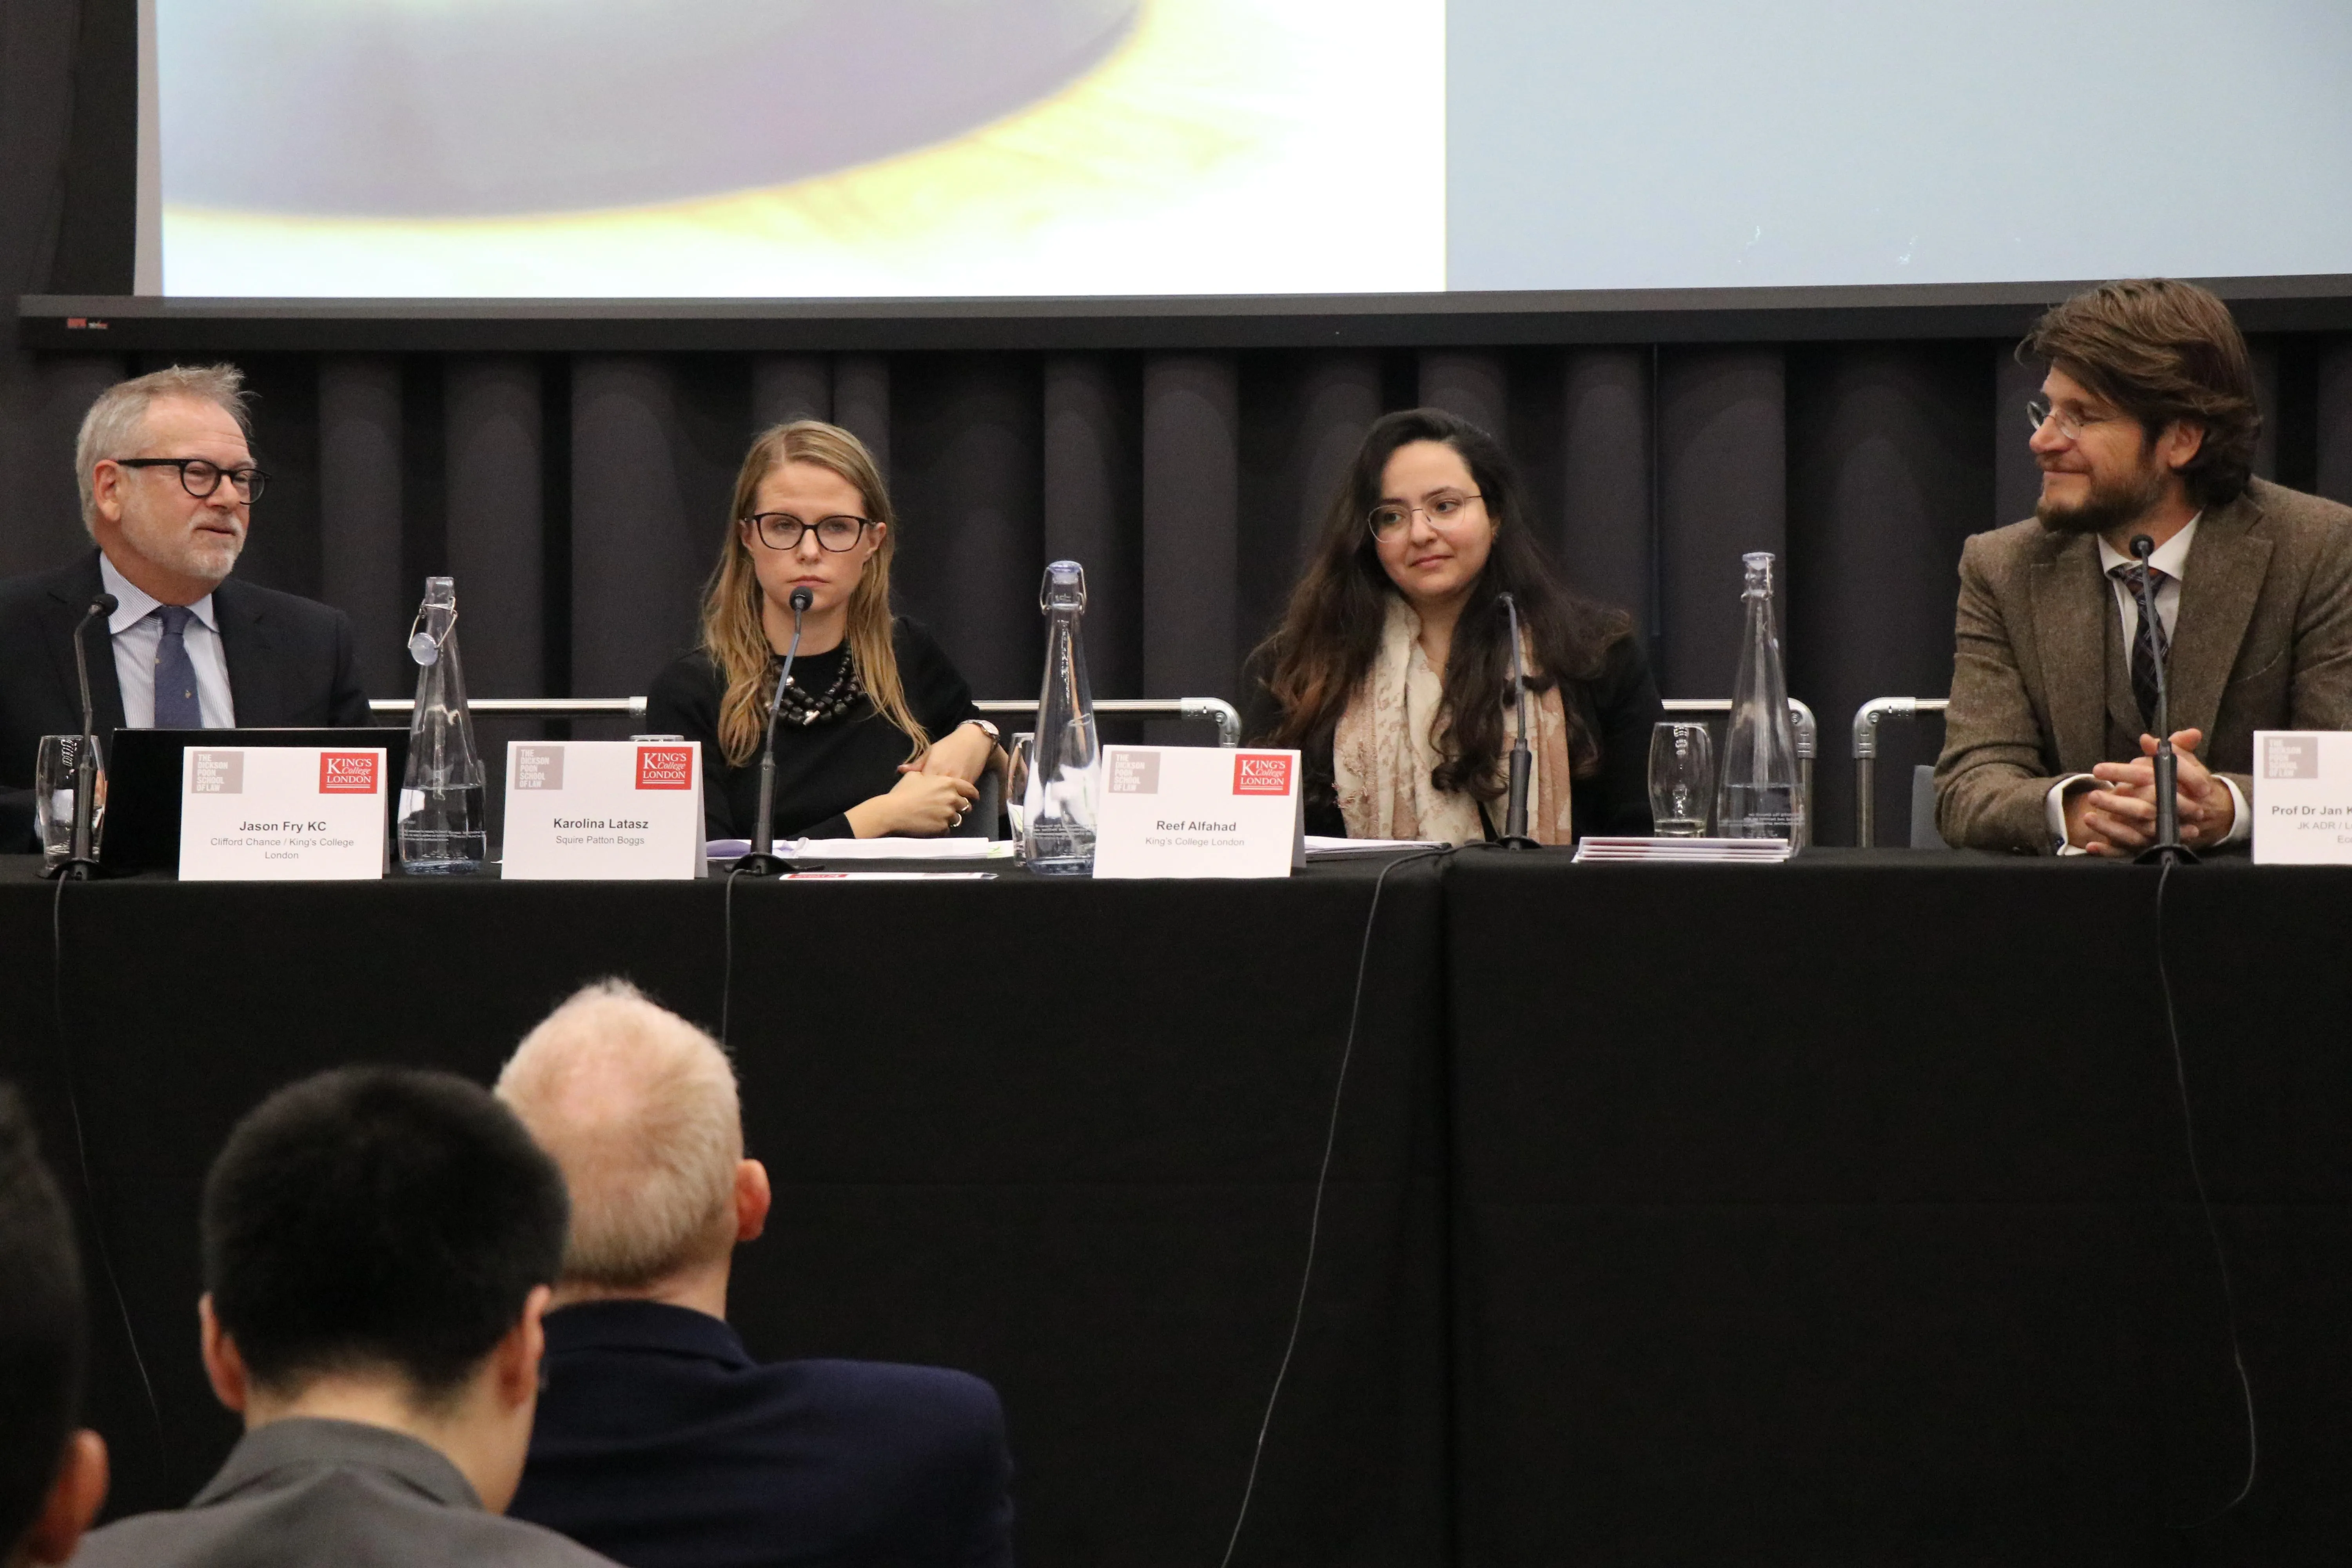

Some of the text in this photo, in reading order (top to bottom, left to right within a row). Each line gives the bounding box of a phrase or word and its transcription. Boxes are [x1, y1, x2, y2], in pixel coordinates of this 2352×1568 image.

[327, 758, 372, 774] KING'S
[643, 753, 686, 769] KING'S
[342, 767, 371, 775] College
[657, 762, 686, 771] College
[1241, 760, 1286, 776] KING'S
[520, 772, 546, 780] SCHOOL
[1255, 769, 1285, 777] College
[1241, 777, 1284, 785] LONDON
[2272, 806, 2298, 815] Prof
[2302, 806, 2316, 815] Dr
[2320, 806, 2342, 815] Jan
[240, 821, 327, 833] Jason Fry KC
[554, 818, 649, 829] Karolina Latasz
[1157, 820, 1236, 831] Reef Alfahad
[289, 838, 317, 848] King's
[319, 838, 354, 848] College
[556, 836, 583, 845] Squire
[617, 837, 645, 846] Boggs
[1145, 837, 1172, 847] King's
[1175, 837, 1209, 847] College
